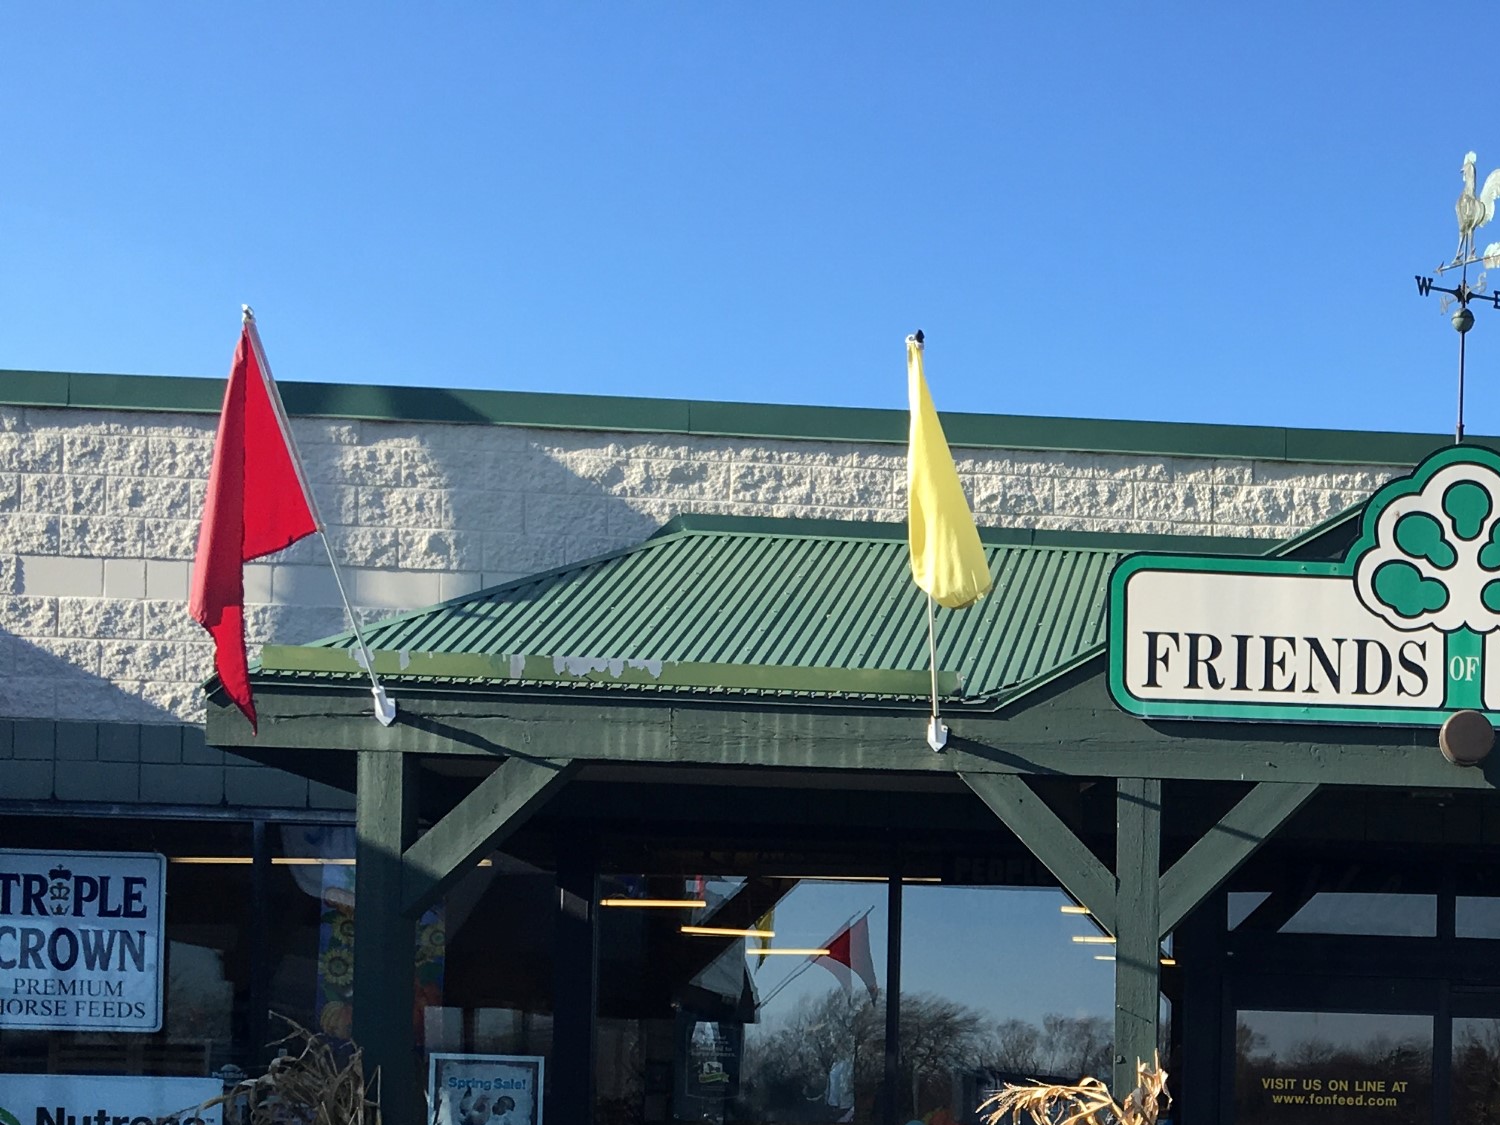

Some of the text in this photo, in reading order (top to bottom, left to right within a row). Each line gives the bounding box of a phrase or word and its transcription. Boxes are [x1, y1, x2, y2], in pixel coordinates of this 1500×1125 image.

[1142, 629, 1429, 697] FRIENDS
[1449, 655, 1480, 682] OF
[13, 977, 123, 997] PREMIUM
[75, 1001, 146, 1018] FEEDS
[448, 1076, 527, 1092] Spring Sale!
[1261, 1078, 1408, 1093] VISIT US ON LINE AT
[1272, 1093, 1397, 1106] www.fonfeed.com
